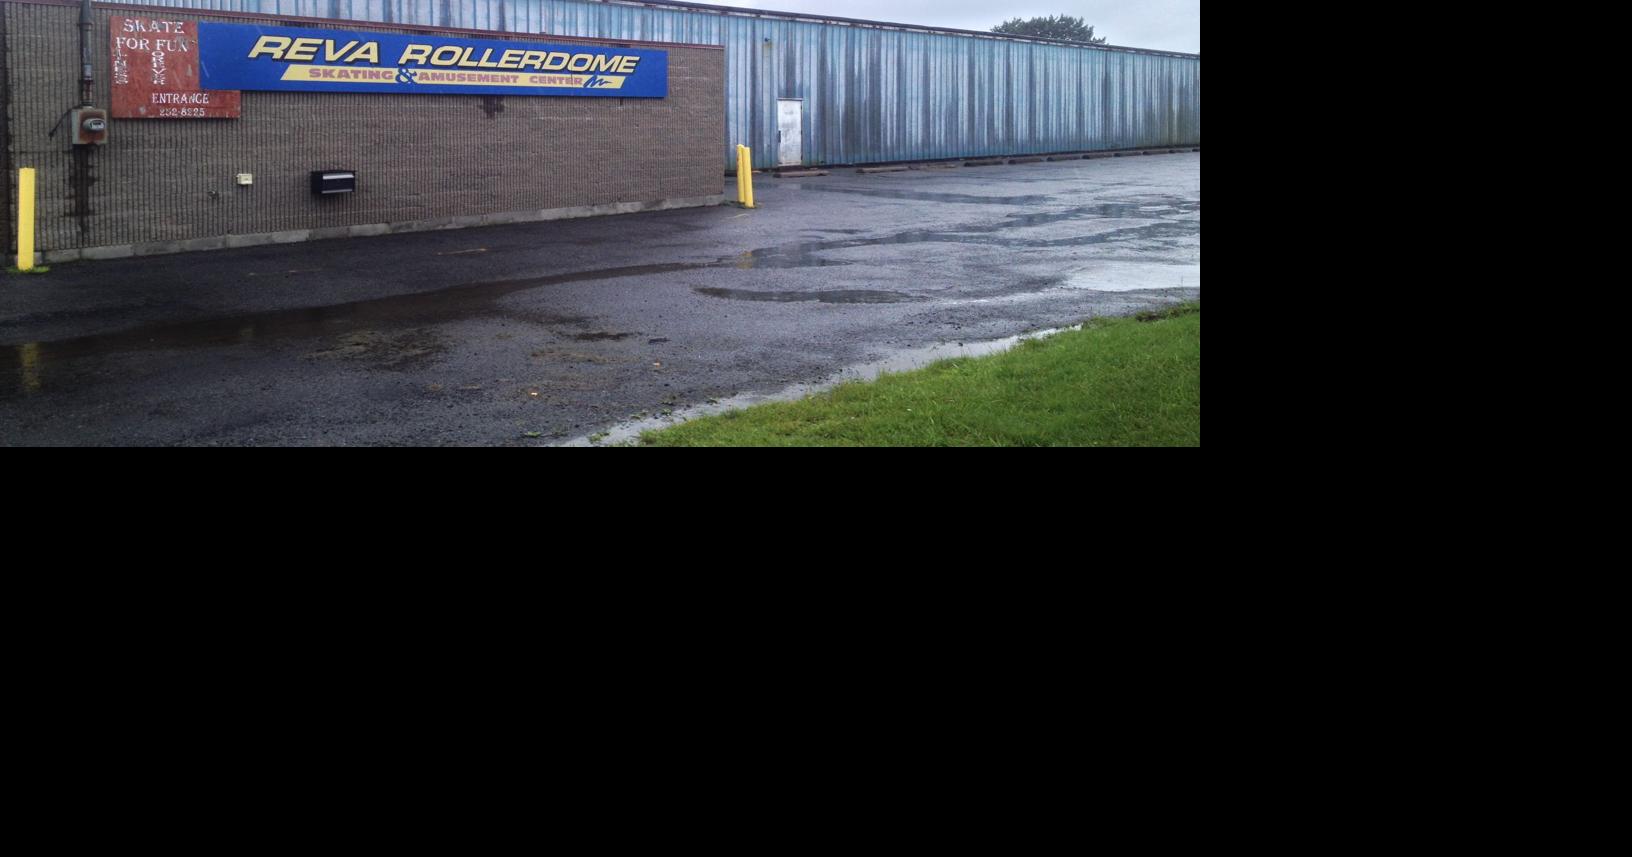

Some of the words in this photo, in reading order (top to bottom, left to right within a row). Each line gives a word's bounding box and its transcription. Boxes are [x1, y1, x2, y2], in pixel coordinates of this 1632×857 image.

[123, 18, 185, 34] SKATE
[115, 36, 150, 51] FOR
[156, 38, 188, 53] FUN
[247, 35, 381, 64] REVA
[397, 43, 640, 73] ROLLERDOME
[308, 68, 394, 81] SKATING
[418, 72, 519, 84] AMUSEMENT
[529, 74, 584, 86] CENTER
[152, 93, 209, 104] ENTRANCE
